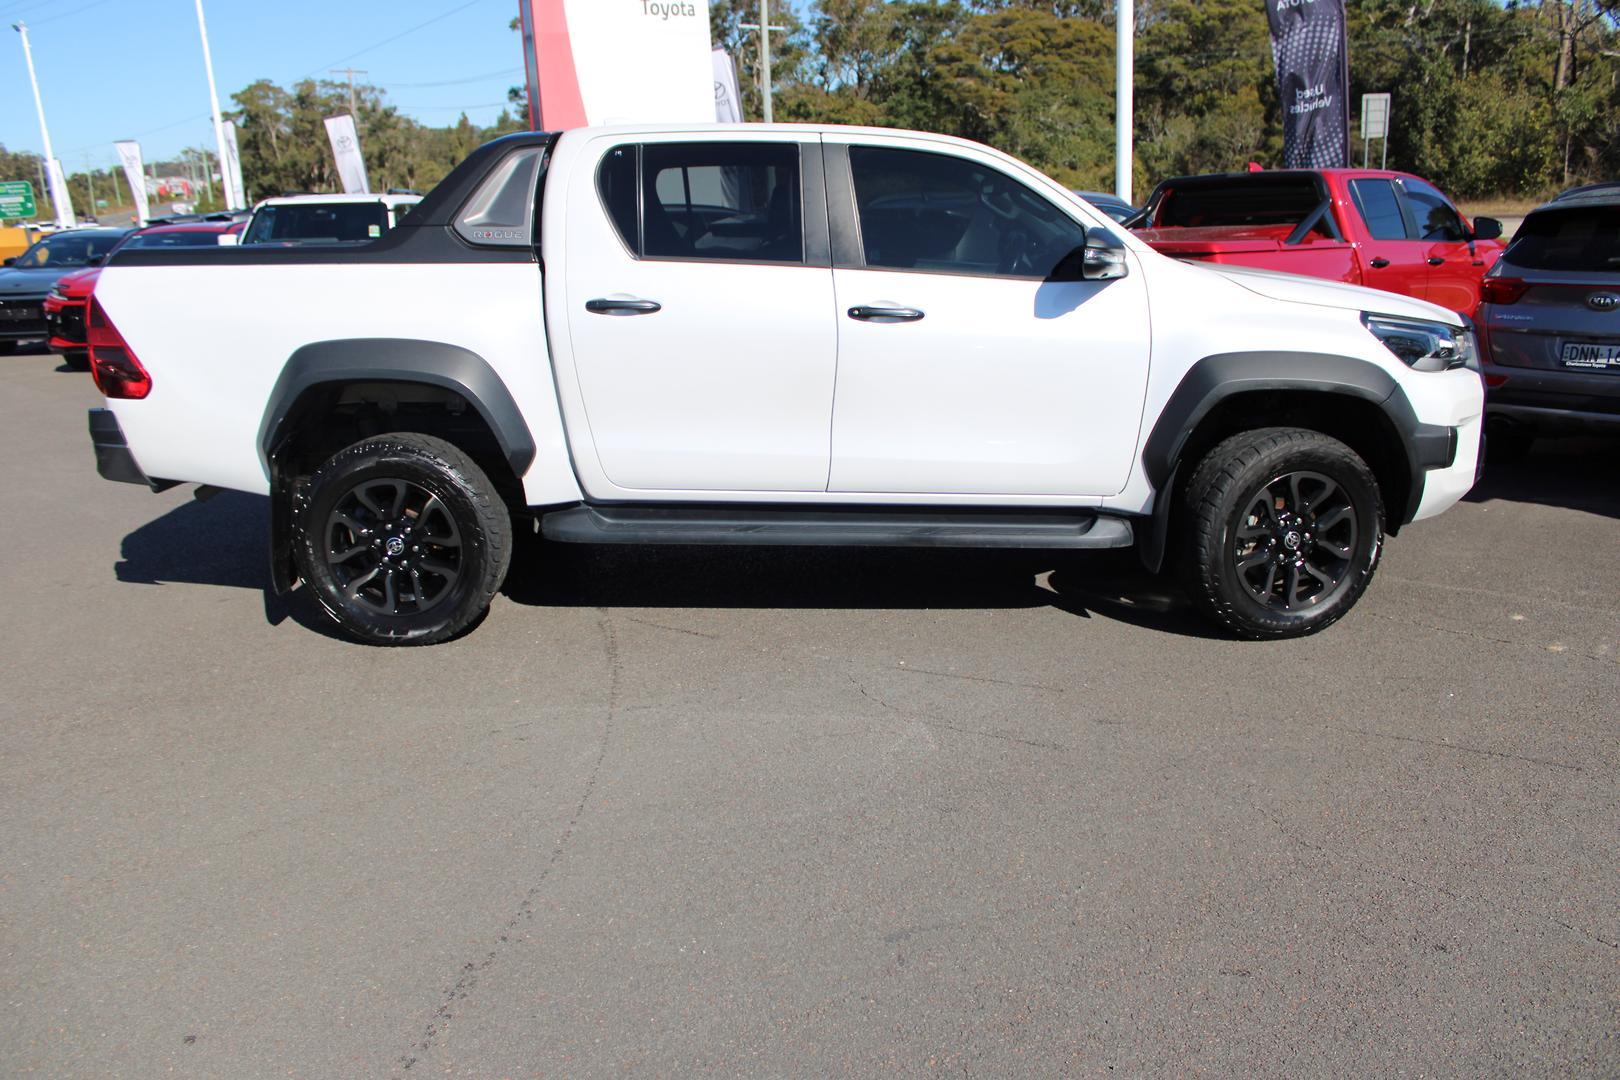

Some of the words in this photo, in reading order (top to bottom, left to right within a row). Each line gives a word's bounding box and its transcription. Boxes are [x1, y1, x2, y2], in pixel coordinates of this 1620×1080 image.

[642, 0, 696, 21] Toyota
[473, 231, 524, 239] ROGUE
[1593, 297, 1611, 305] KIA
